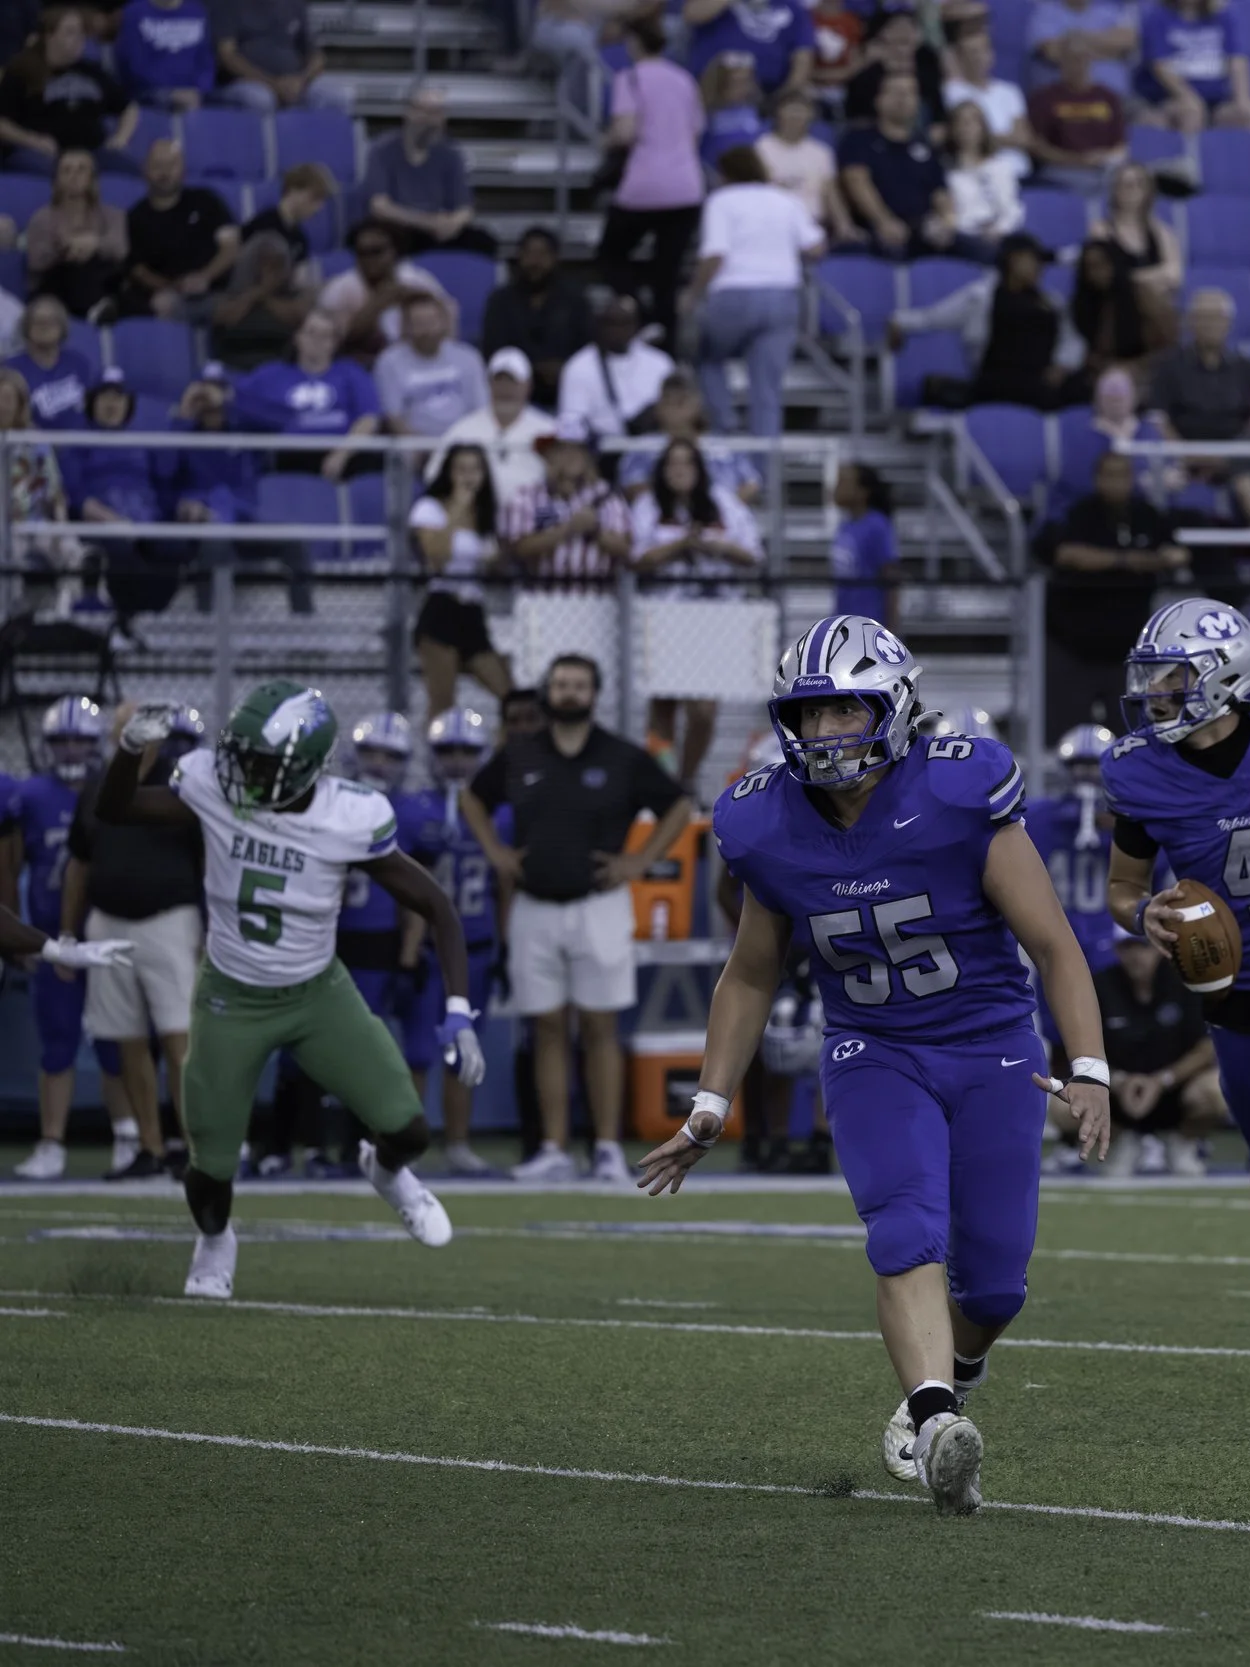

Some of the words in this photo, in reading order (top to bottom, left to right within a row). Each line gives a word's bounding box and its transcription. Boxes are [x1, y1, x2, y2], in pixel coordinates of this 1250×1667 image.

[1199, 611, 1241, 639] M
[876, 630, 907, 664] M
[797, 677, 828, 688] Vikings
[230, 834, 306, 873] EAGLES
[831, 878, 891, 897] Vikings
[237, 867, 288, 945] 5
[807, 892, 961, 1005] 55
[835, 1041, 862, 1060] M
